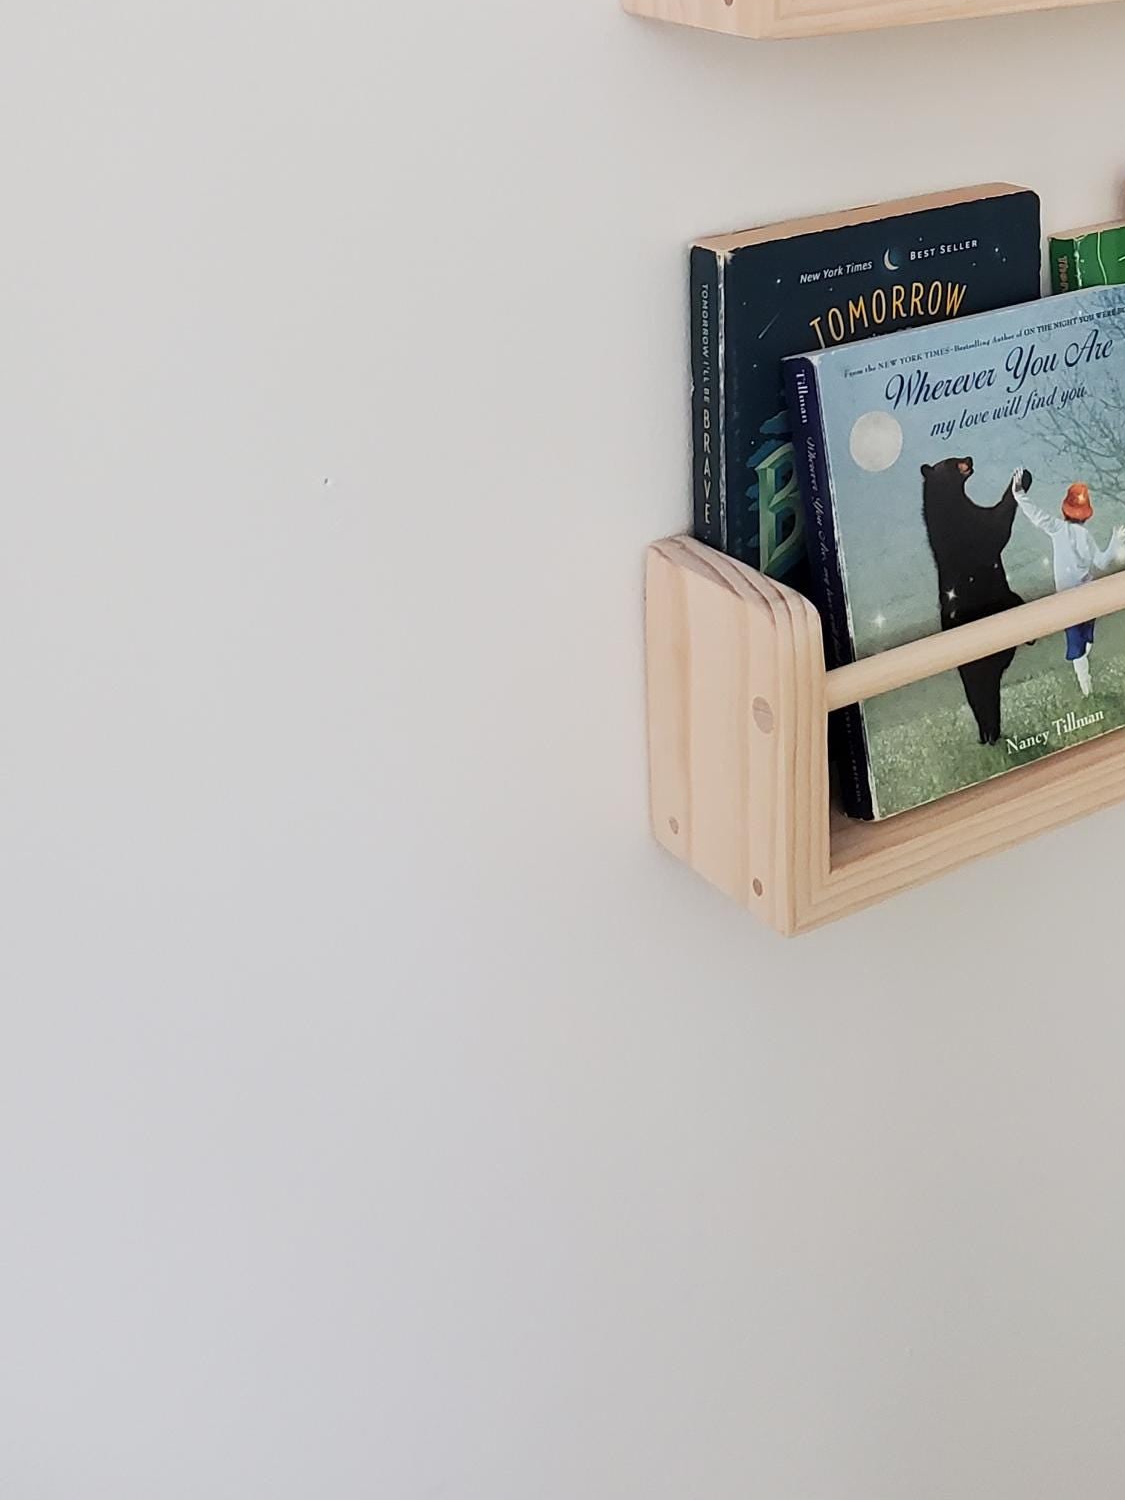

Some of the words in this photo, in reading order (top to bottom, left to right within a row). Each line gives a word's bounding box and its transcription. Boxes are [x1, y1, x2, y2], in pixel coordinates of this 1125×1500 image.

[800, 270, 821, 284] New
[823, 265, 844, 279] York
[846, 261, 873, 274] Times
[910, 248, 936, 261] BEST
[940, 240, 978, 254] SELLER
[701, 284, 710, 355] TOMORROW
[809, 280, 967, 349] TOMORROW
[865, 364, 877, 373] the
[878, 359, 898, 371] NEW
[900, 354, 923, 366] YORK
[1023, 327, 1036, 336] ON
[1037, 323, 1053, 333] THE
[1053, 317, 1078, 330] NIGHT
[1079, 313, 1094, 324] YOU
[885, 368, 996, 410] Wherever
[1005, 345, 1058, 393] You
[1064, 329, 1113, 367] Are
[703, 388, 711, 403] BE
[795, 369, 807, 424] Tillman
[930, 418, 955, 440] my
[959, 409, 990, 431] love
[992, 395, 1022, 420] will
[1018, 386, 1057, 420] find
[703, 408, 711, 524] BRAVE
[1005, 730, 1050, 754] Nancy
[1052, 710, 1104, 737] Tillman
